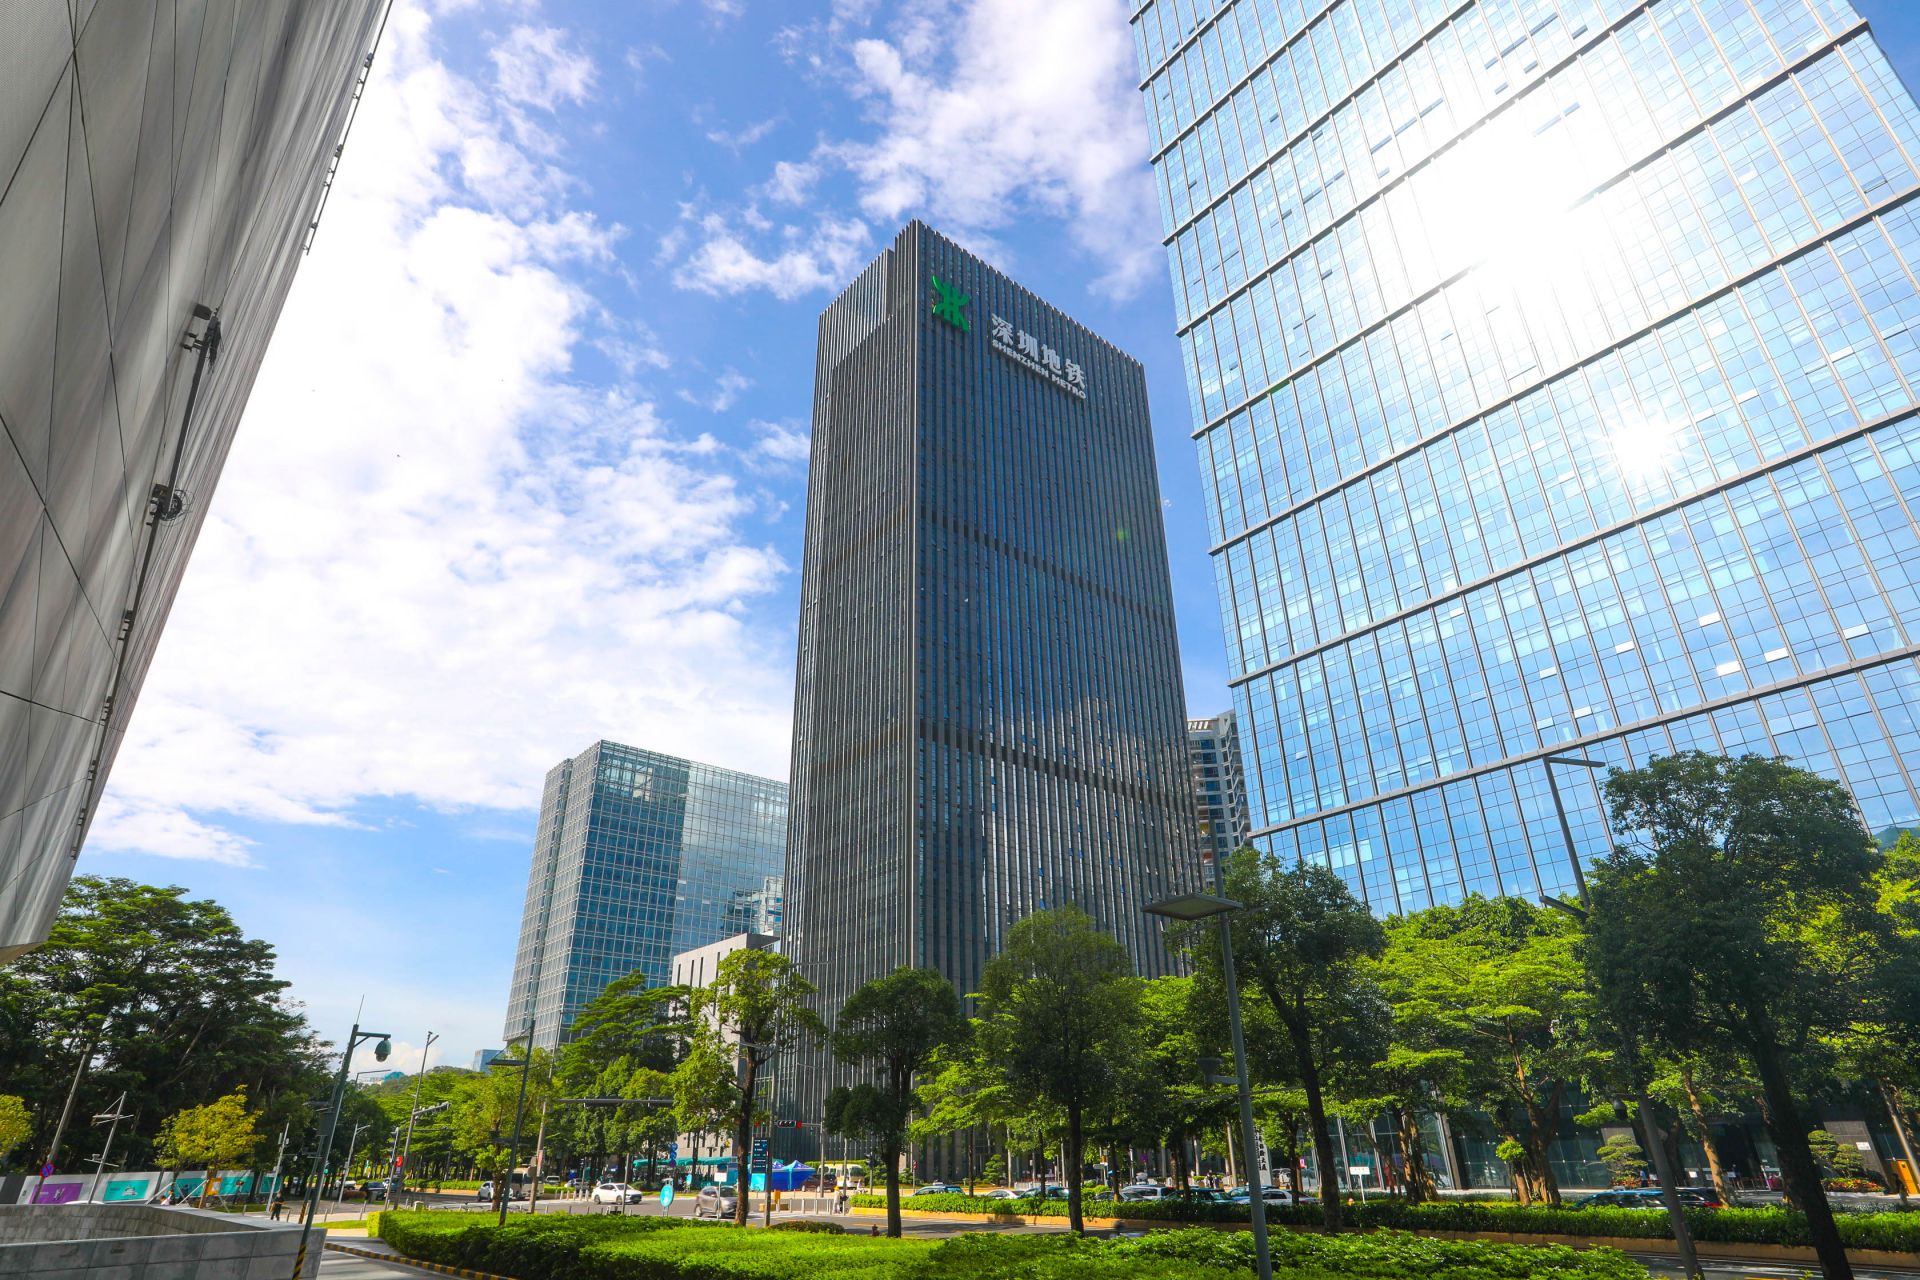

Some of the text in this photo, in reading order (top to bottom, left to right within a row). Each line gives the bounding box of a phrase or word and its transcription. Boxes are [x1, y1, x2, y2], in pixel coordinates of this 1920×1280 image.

[992, 313, 1086, 390] 深圳地铁
[992, 339, 1086, 399] SHENZHEN METRO
